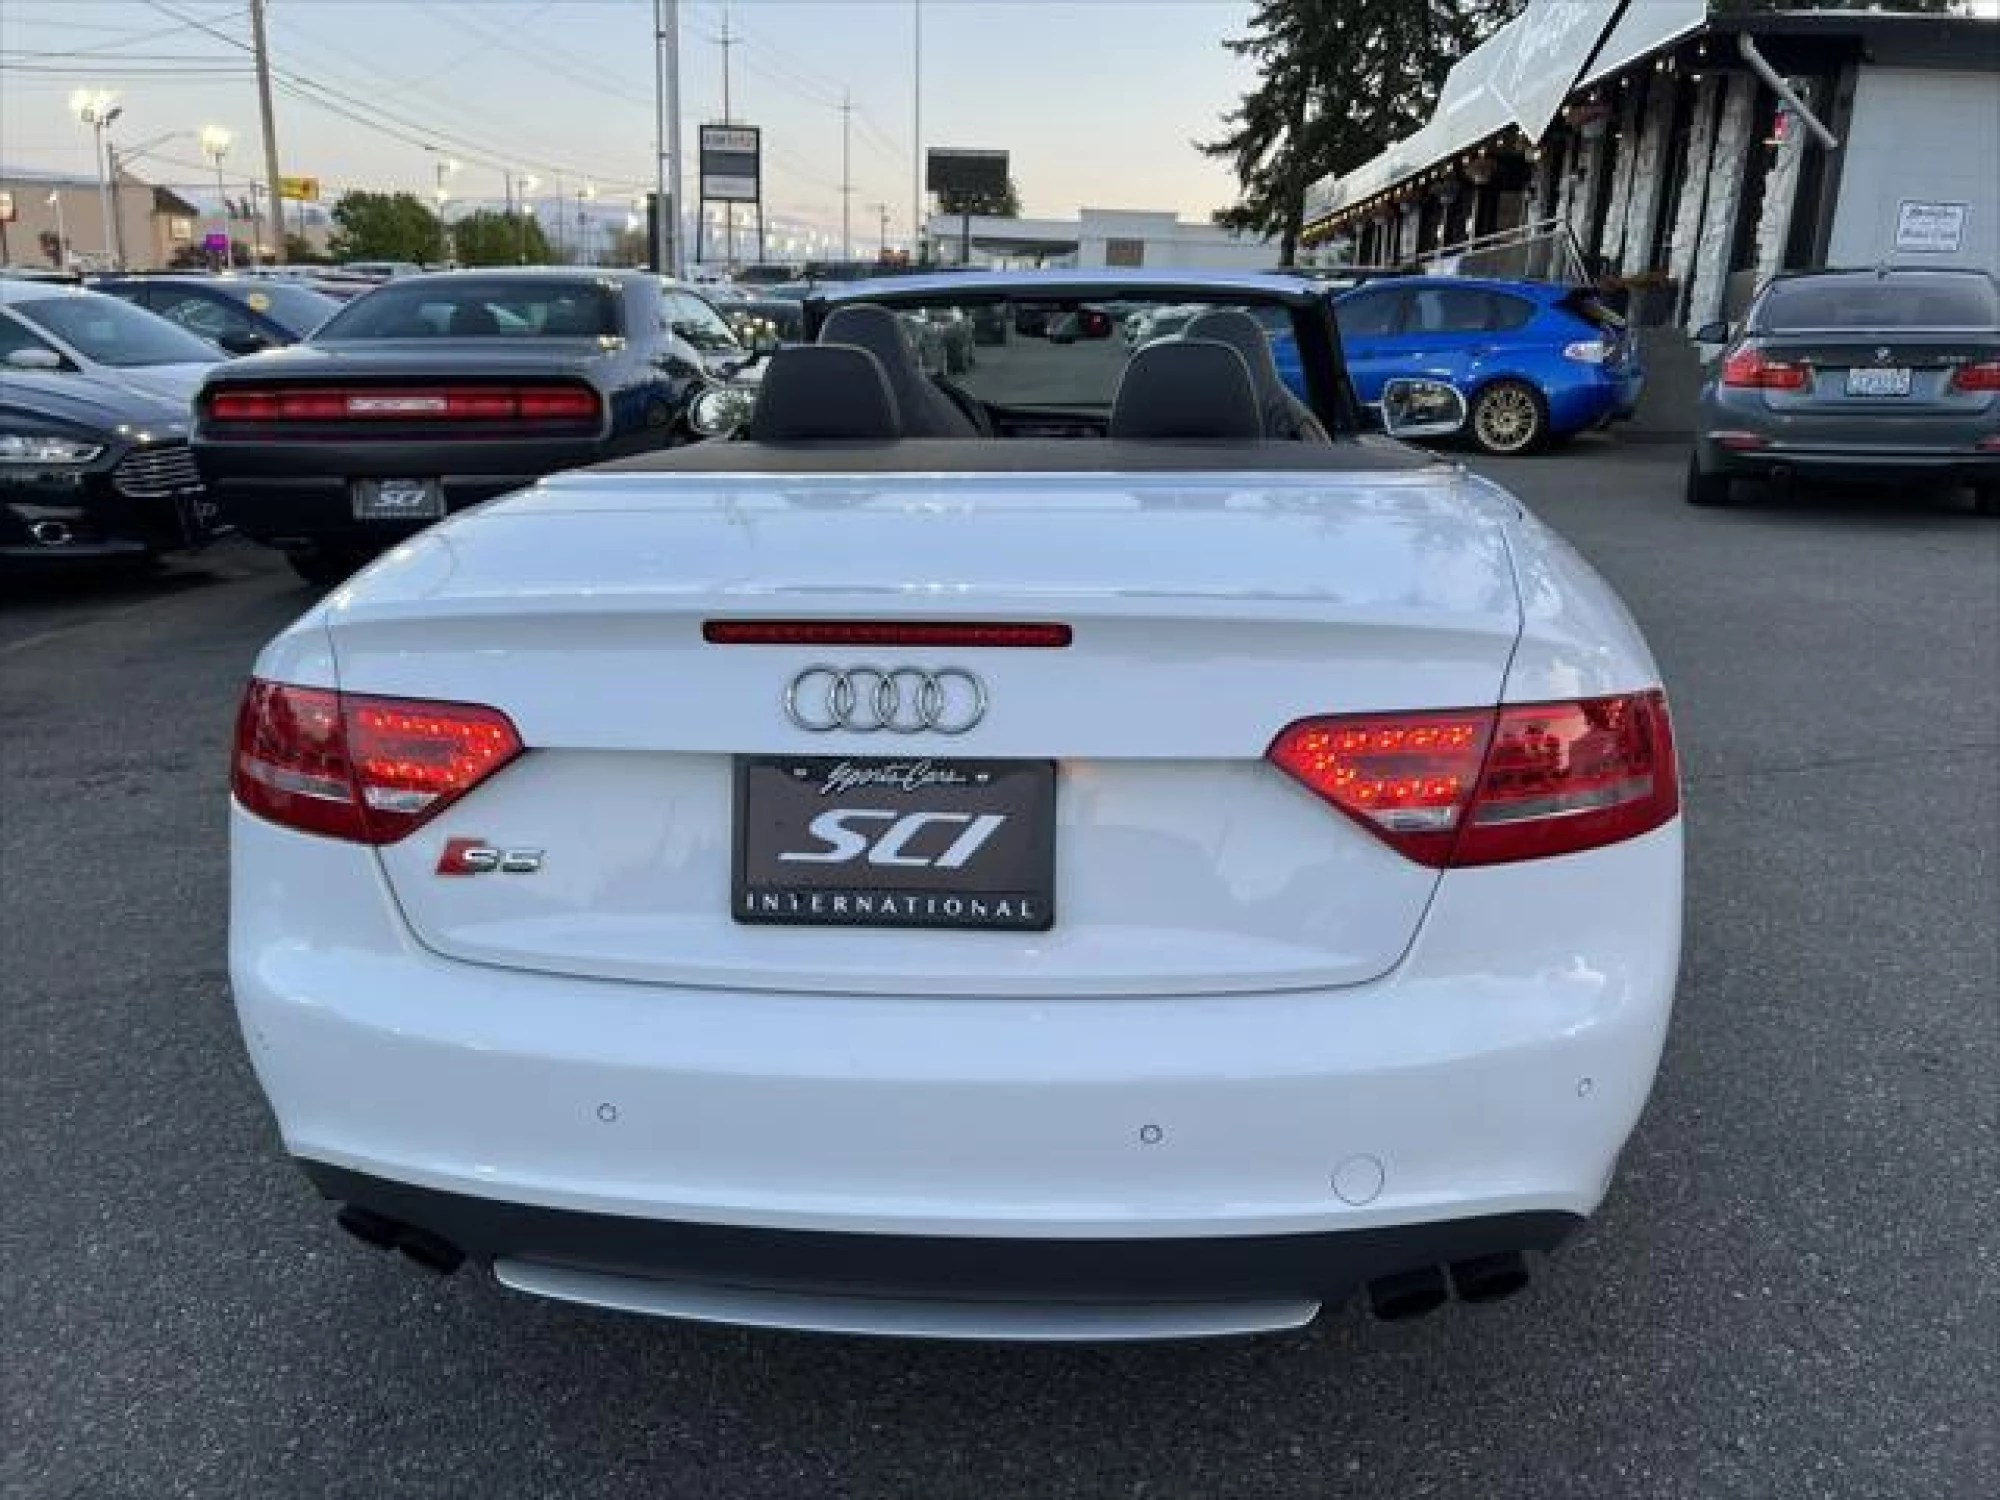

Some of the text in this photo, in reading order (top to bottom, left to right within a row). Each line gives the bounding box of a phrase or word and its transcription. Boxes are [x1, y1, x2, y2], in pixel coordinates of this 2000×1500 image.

[777, 808, 1008, 868] SCI
[458, 846, 548, 875] S5
[745, 892, 1035, 919] INTERNATIONAL
